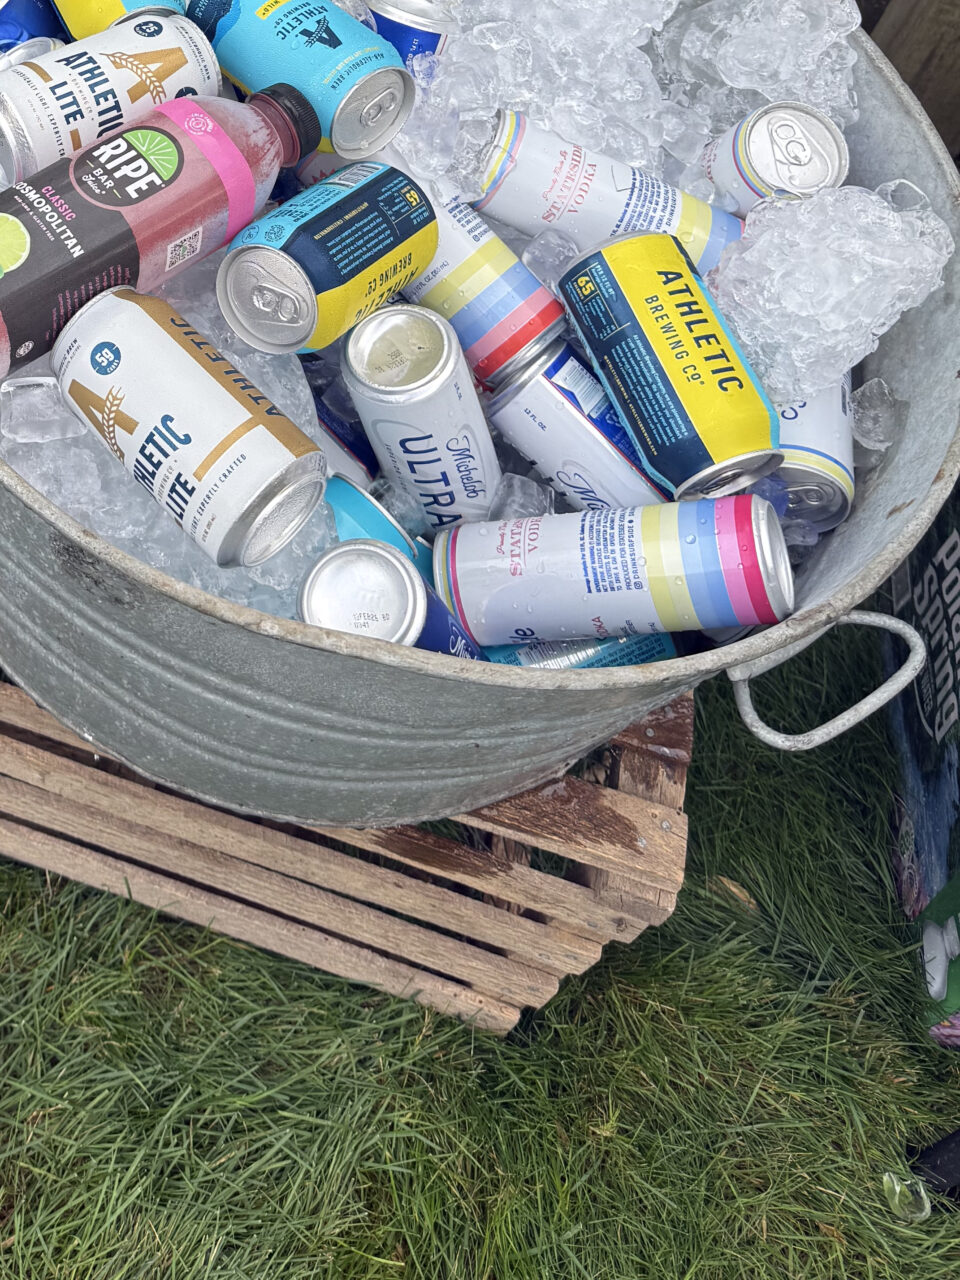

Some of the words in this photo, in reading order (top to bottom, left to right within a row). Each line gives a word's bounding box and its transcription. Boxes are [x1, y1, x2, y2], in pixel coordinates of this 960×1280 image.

[262, 0, 279, 16] WILD
[276, 4, 330, 41] ATHLETIC
[283, 2, 311, 21] BREWING
[142, 23, 158, 34] 25
[49, 81, 85, 125] LITE
[46, 112, 64, 147] EXPERTLY
[82, 174, 105, 195] Juice
[92, 138, 162, 199] RIPE
[92, 167, 115, 189] BAR
[41, 185, 76, 222] CLASSIC
[406, 190, 420, 206] 65
[567, 163, 597, 216] VODKA
[13, 181, 85, 259] COSMOPOLITAN
[32, 214, 47, 231] GLUTEN
[44, 230, 55, 241] FREE
[379, 252, 413, 281] BREWING
[576, 274, 595, 296] 65
[644, 295, 690, 365] BREWING
[656, 270, 744, 392] ATHLETIC
[95, 347, 115, 367] 5g
[170, 316, 287, 418] ATHLETIC
[523, 407, 531, 415] 12
[197, 484, 220, 517] EXPERTLY
[218, 453, 247, 484] CRAFTED
[398, 433, 463, 529] ULTRA
[446, 435, 487, 499] Michelob
[166, 472, 196, 520] LITE
[623, 562, 632, 590] PRODUCED
[914, 564, 960, 745] Spring
